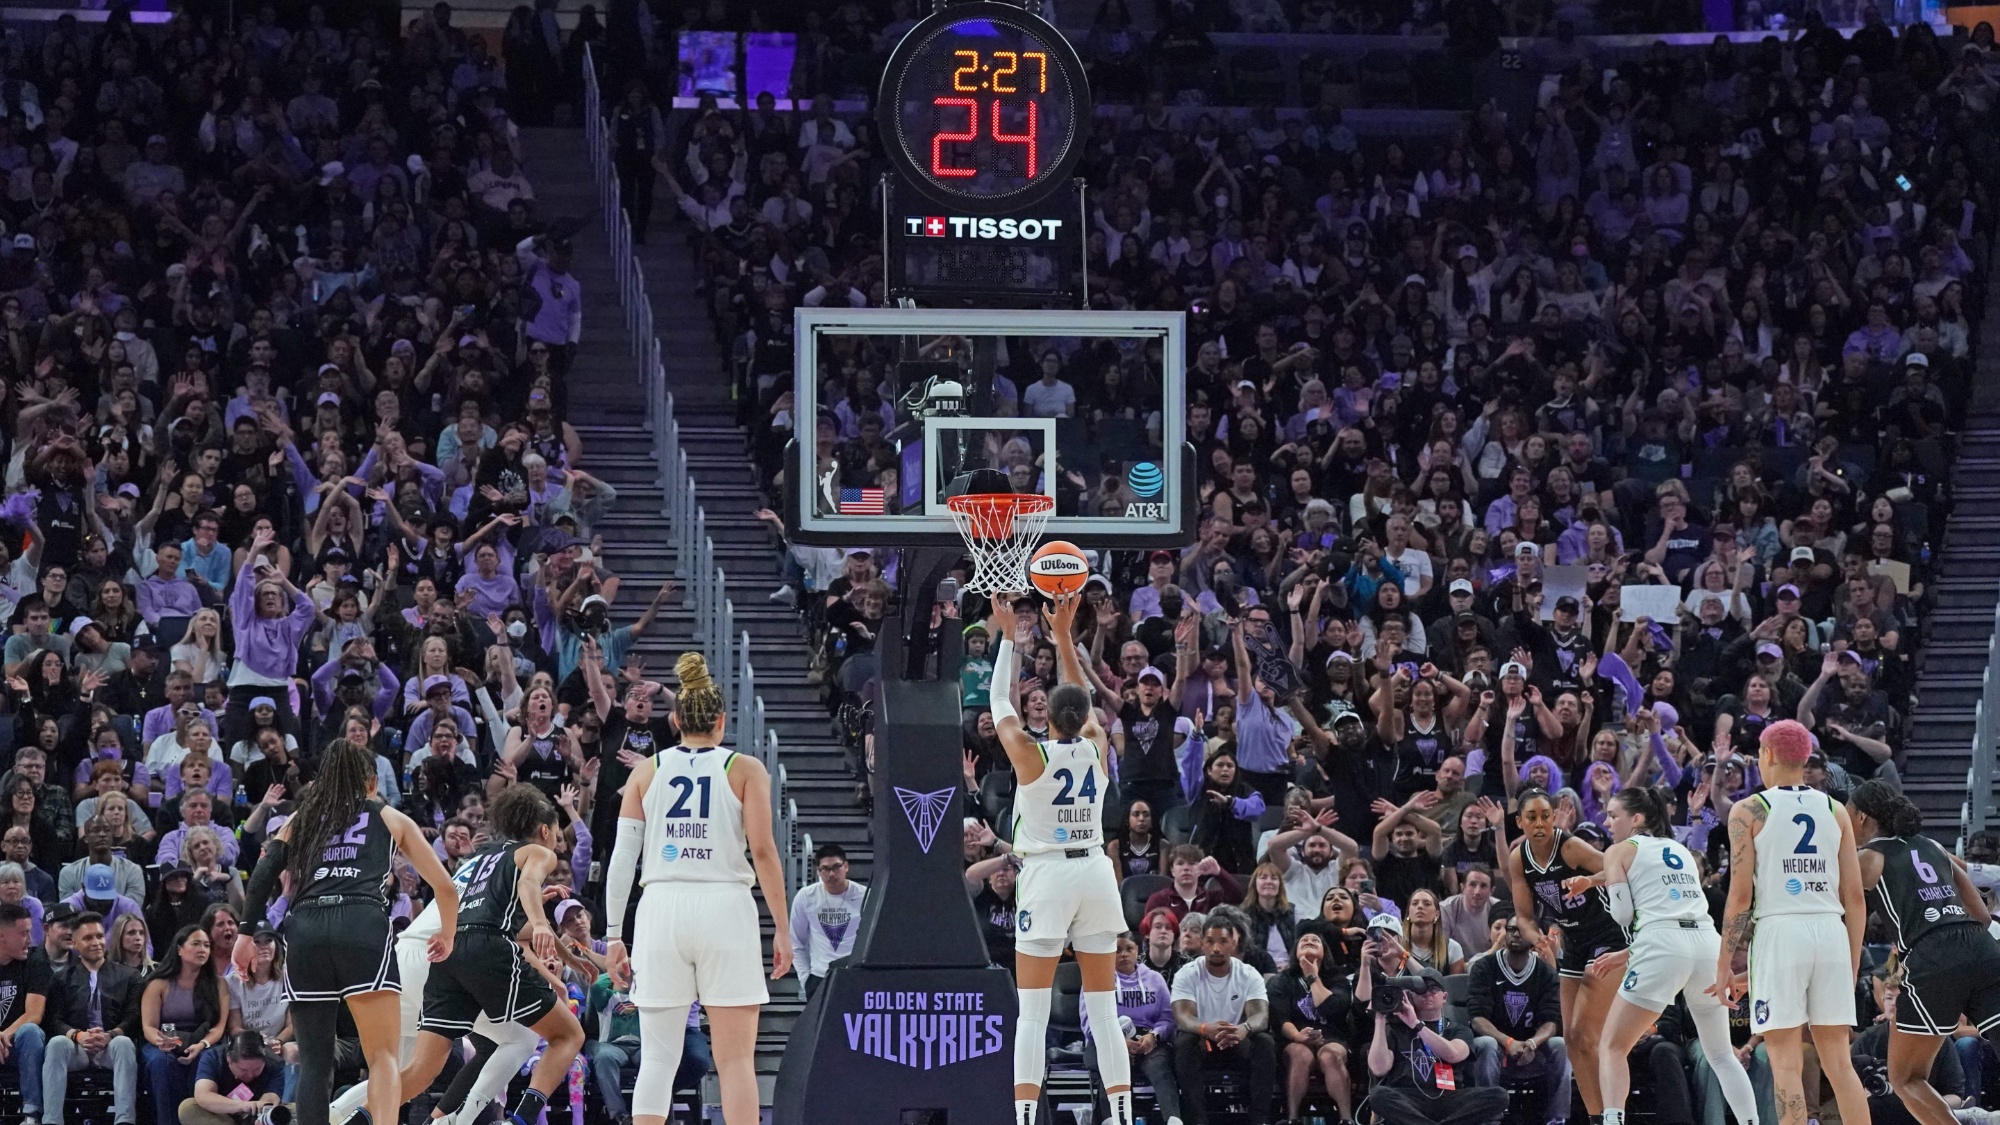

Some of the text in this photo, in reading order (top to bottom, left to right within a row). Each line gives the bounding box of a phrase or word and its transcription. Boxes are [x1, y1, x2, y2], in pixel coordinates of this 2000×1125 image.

[954, 50, 1047, 93] 2:27
[932, 98, 1036, 178] 24
[949, 217, 1062, 240] TISSOT
[1124, 502, 1168, 518] AT&T
[1041, 559, 1079, 571] Wilson
[1052, 764, 1097, 805] 24
[665, 775, 711, 818] 21
[1057, 808, 1092, 823] COLLIER
[666, 823, 708, 839] McBRIDE
[1069, 829, 1093, 840] AT&T
[1792, 813, 1817, 854] 2
[323, 846, 358, 862] BURTON
[681, 847, 713, 860] AT&T
[1662, 846, 1684, 870] 6
[330, 866, 361, 878] AT&T
[473, 850, 506, 884] 13
[1782, 858, 1826, 874] HIEDEMAN
[1910, 849, 1938, 884] 6
[1661, 873, 1697, 886] CARLETON
[1804, 881, 1829, 892] AT&T
[1918, 884, 1956, 901] CHARLES
[818, 912, 851, 925] VALKYRIES
[864, 991, 984, 1011] GOLDEN STATE
[843, 1012, 1003, 1071] VALKYRIES
